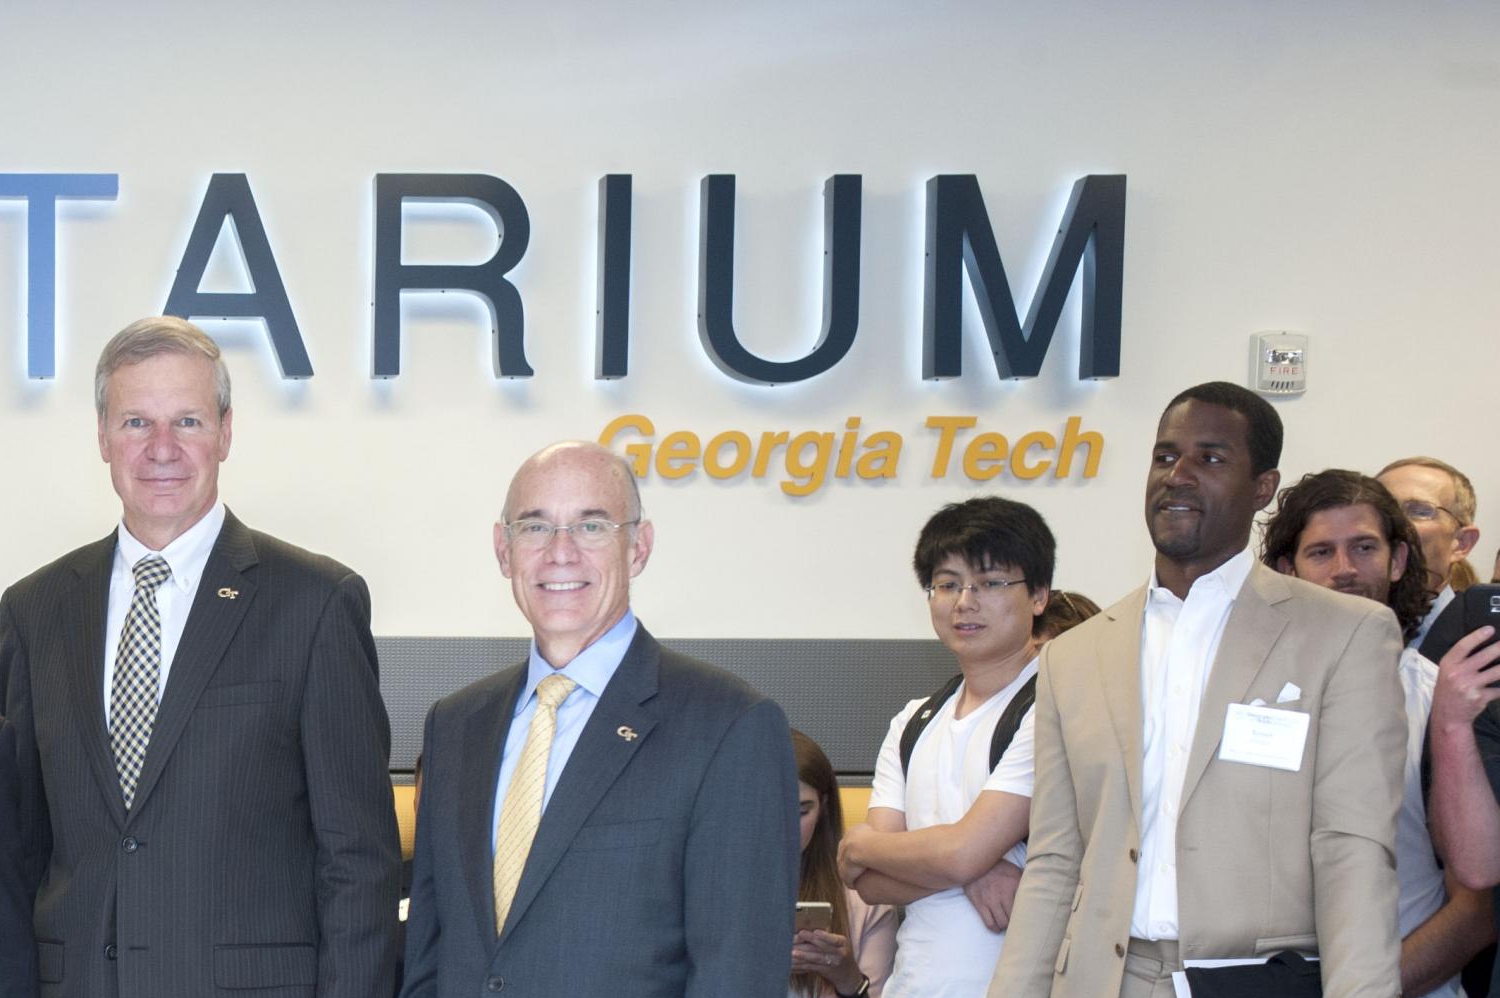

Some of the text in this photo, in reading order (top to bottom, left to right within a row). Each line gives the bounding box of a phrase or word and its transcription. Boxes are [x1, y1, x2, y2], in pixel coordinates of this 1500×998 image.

[1269, 367, 1300, 376] FIRE
[598, 414, 1105, 496] Georgia Tech
